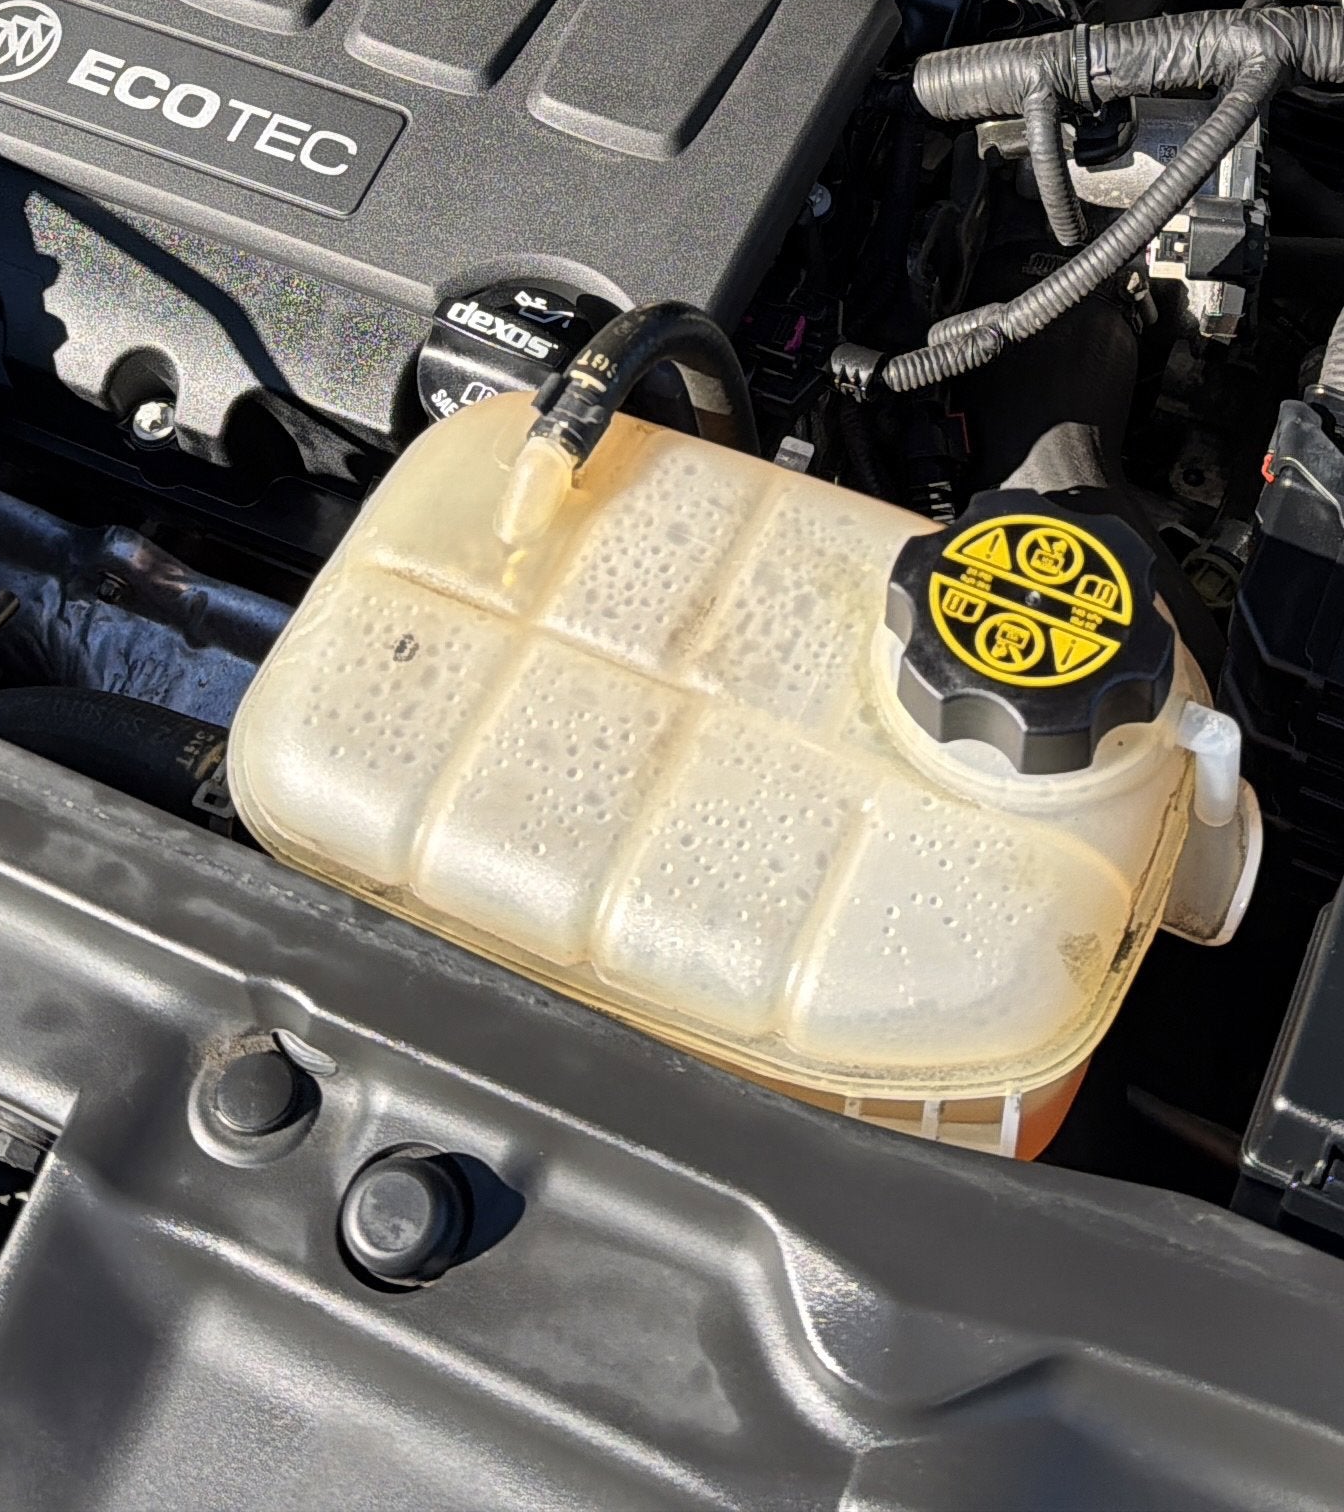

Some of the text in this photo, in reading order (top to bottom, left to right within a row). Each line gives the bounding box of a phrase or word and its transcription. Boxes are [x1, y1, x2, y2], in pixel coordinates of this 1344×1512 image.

[67, 48, 358, 176] ECOTEC
[447, 301, 554, 359] dexos
[431, 389, 459, 418] SAE
